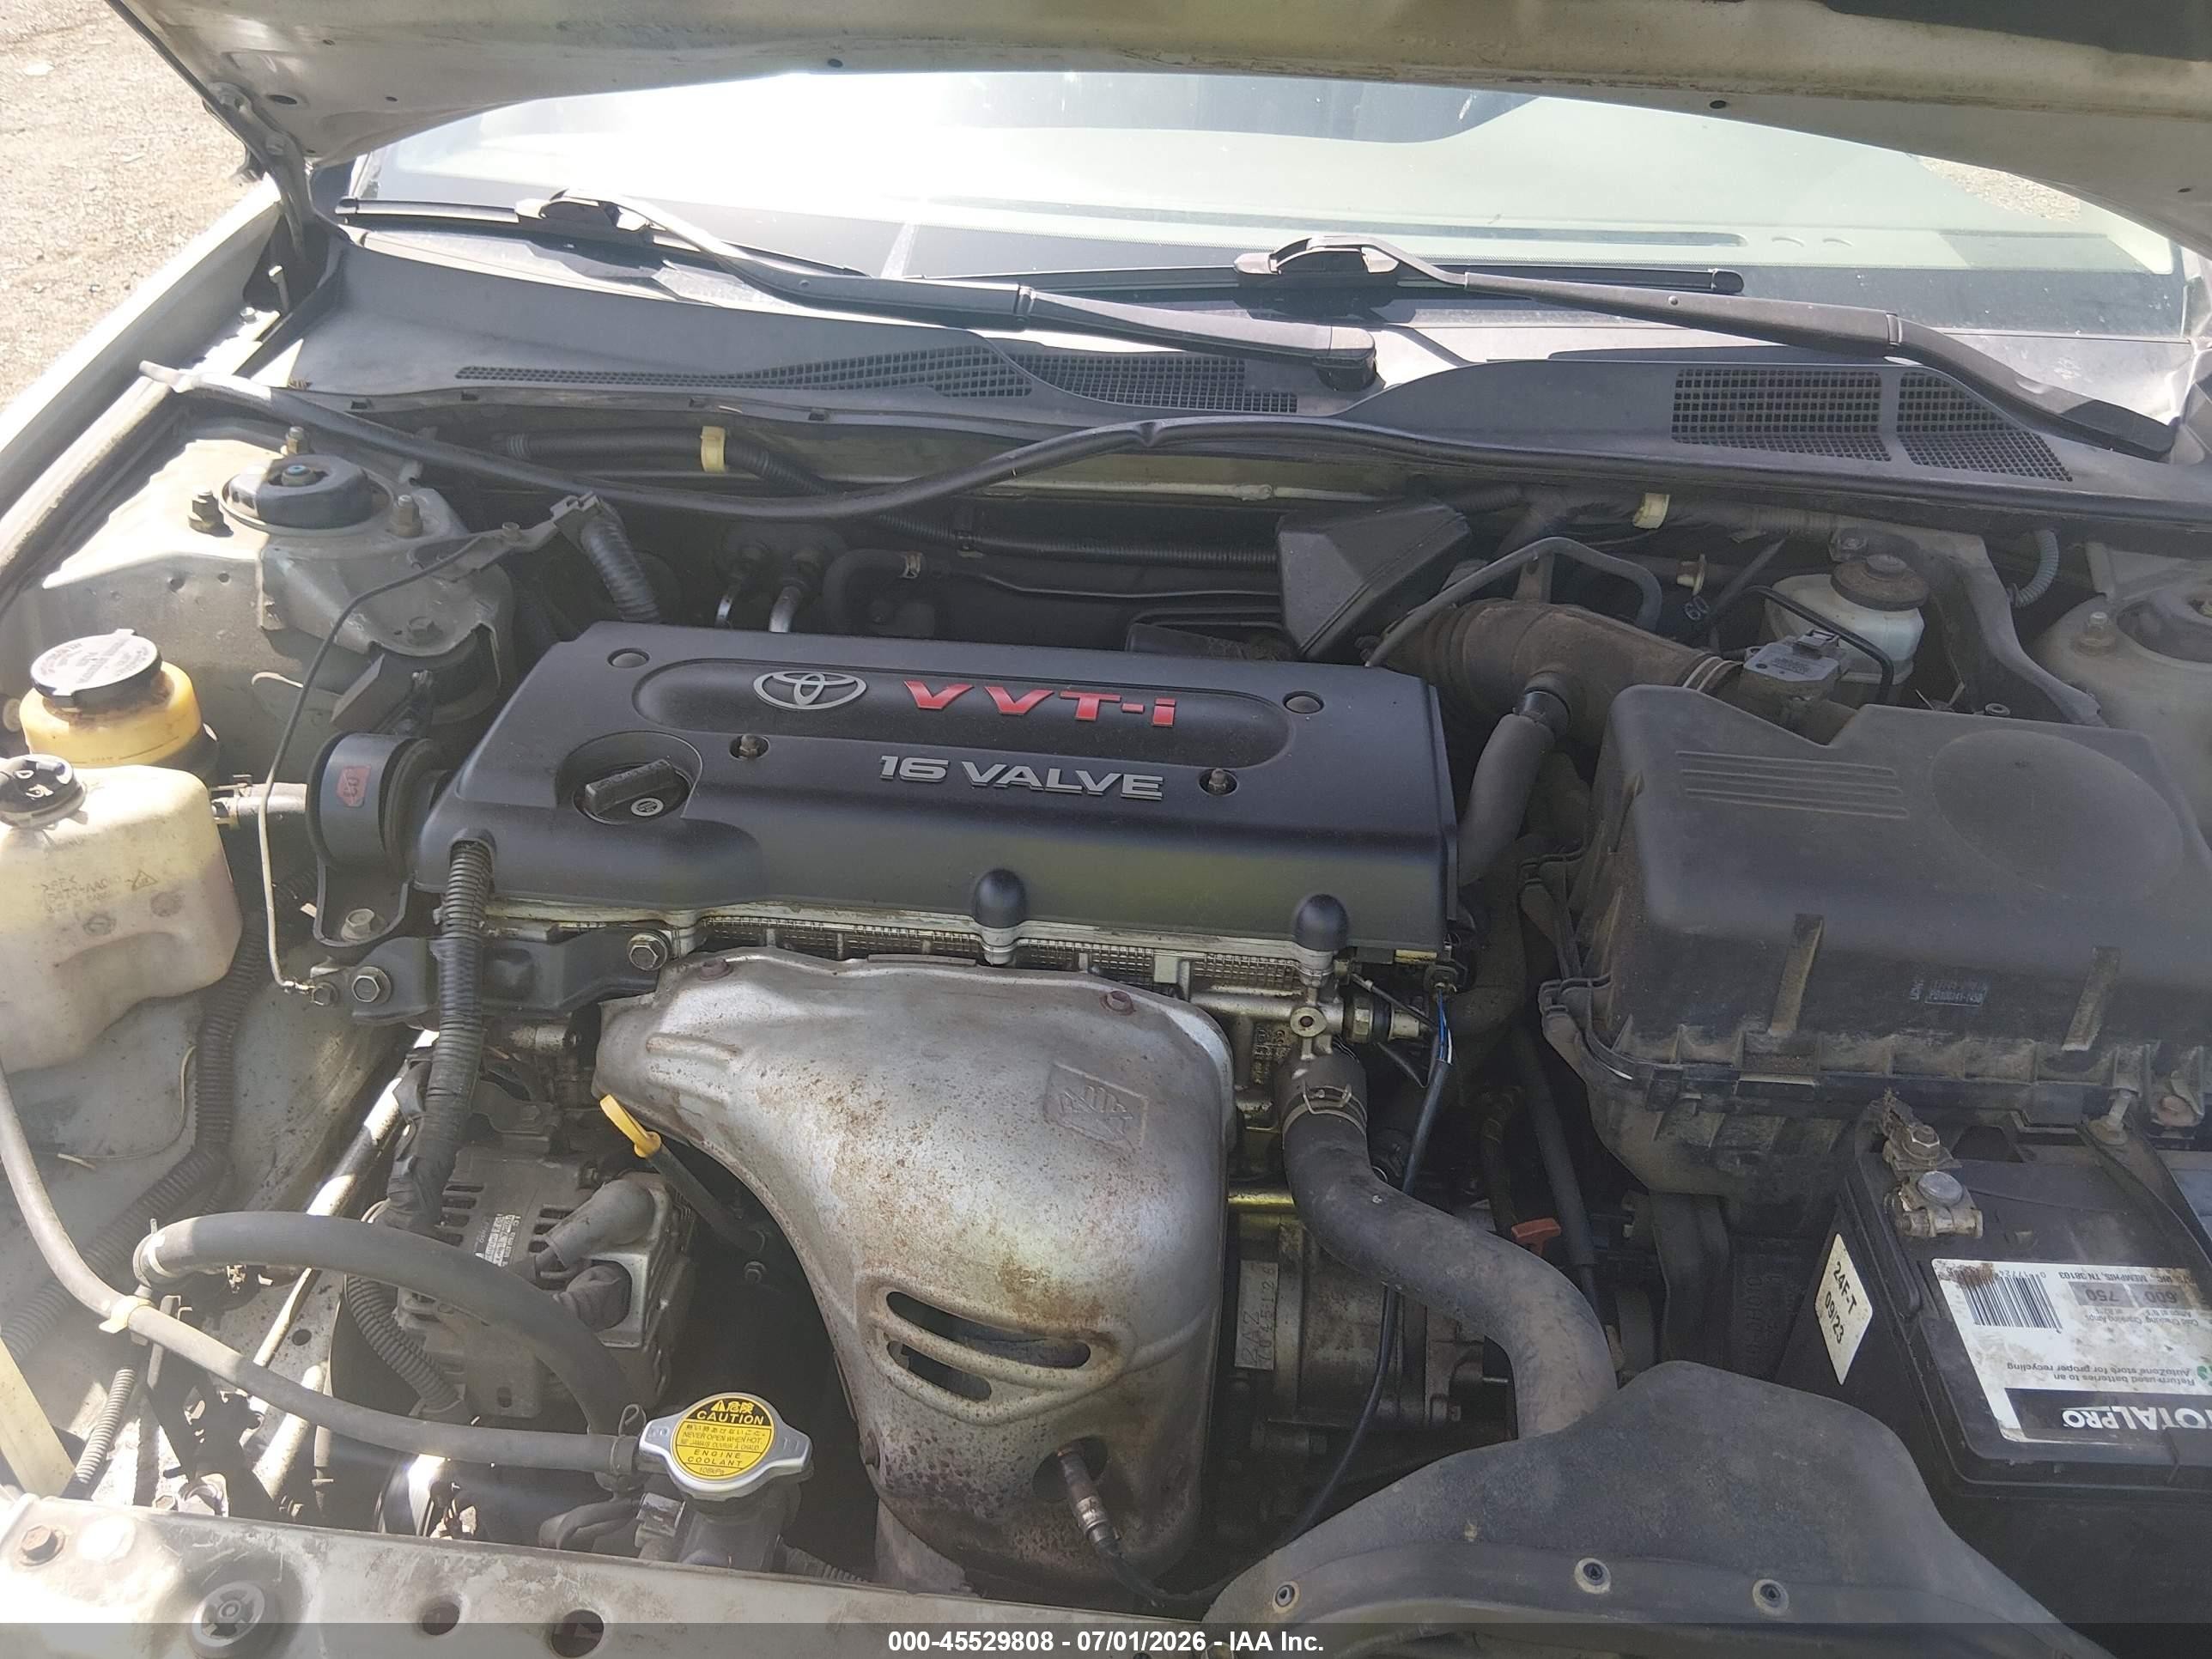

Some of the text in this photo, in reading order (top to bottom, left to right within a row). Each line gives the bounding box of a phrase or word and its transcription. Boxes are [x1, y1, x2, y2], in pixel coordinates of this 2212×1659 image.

[904, 680, 1176, 727] VVT-i
[880, 756, 1164, 800] 16 VALVE
[2102, 1273, 2147, 1282] MEMPHIS,
[1833, 1261, 1857, 1316] 24F-T
[2085, 1289, 2119, 1302] 750
[2144, 1291, 2177, 1303] 600
[1824, 1291, 1845, 1345] 09/23
[2007, 1363, 2053, 1371] recycling
[2081, 1374, 2128, 1382] batteries
[2131, 1376, 2157, 1384] used
[697, 1411, 764, 1425] CAUTION
[694, 1449, 742, 1459] ENGINE
[687, 1456, 743, 1467] COOLANT
